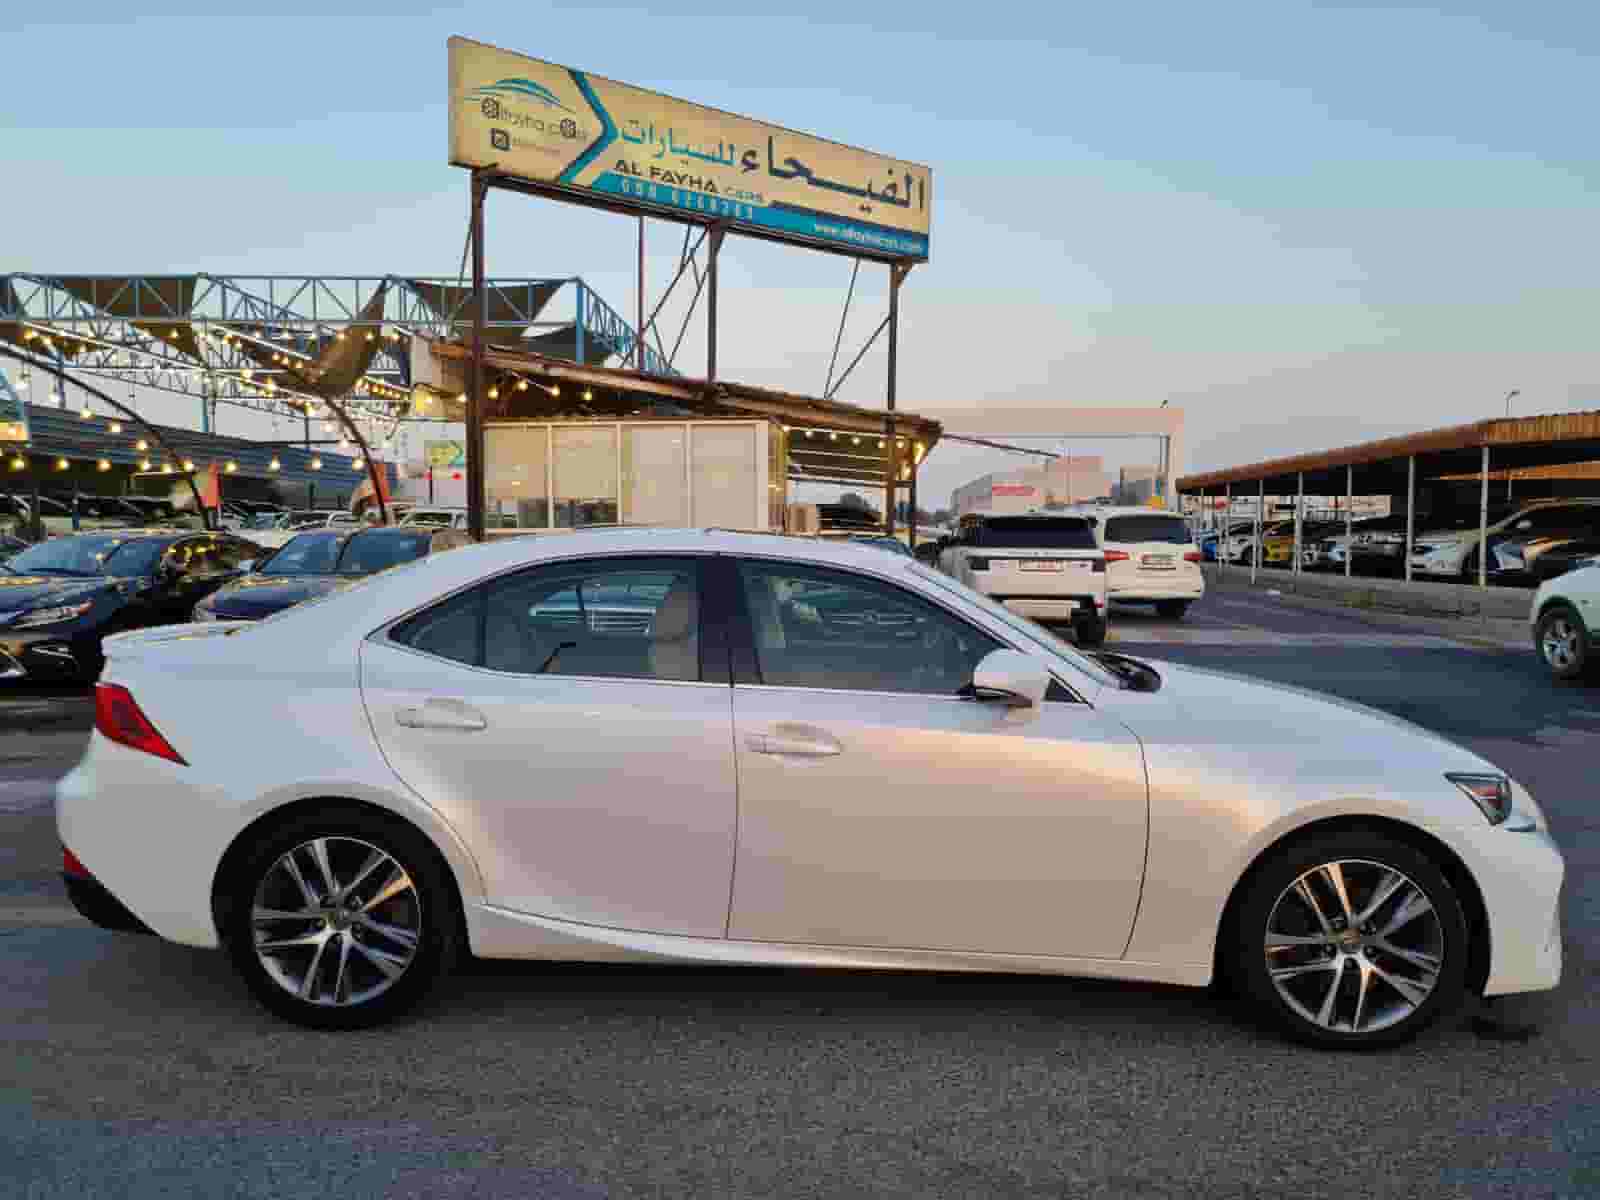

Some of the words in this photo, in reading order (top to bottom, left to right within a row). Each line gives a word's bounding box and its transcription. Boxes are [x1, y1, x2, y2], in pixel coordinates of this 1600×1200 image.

[615, 159, 643, 176] AL
[650, 166, 718, 193] FAYHA
[741, 135, 924, 216] الفيحاء
